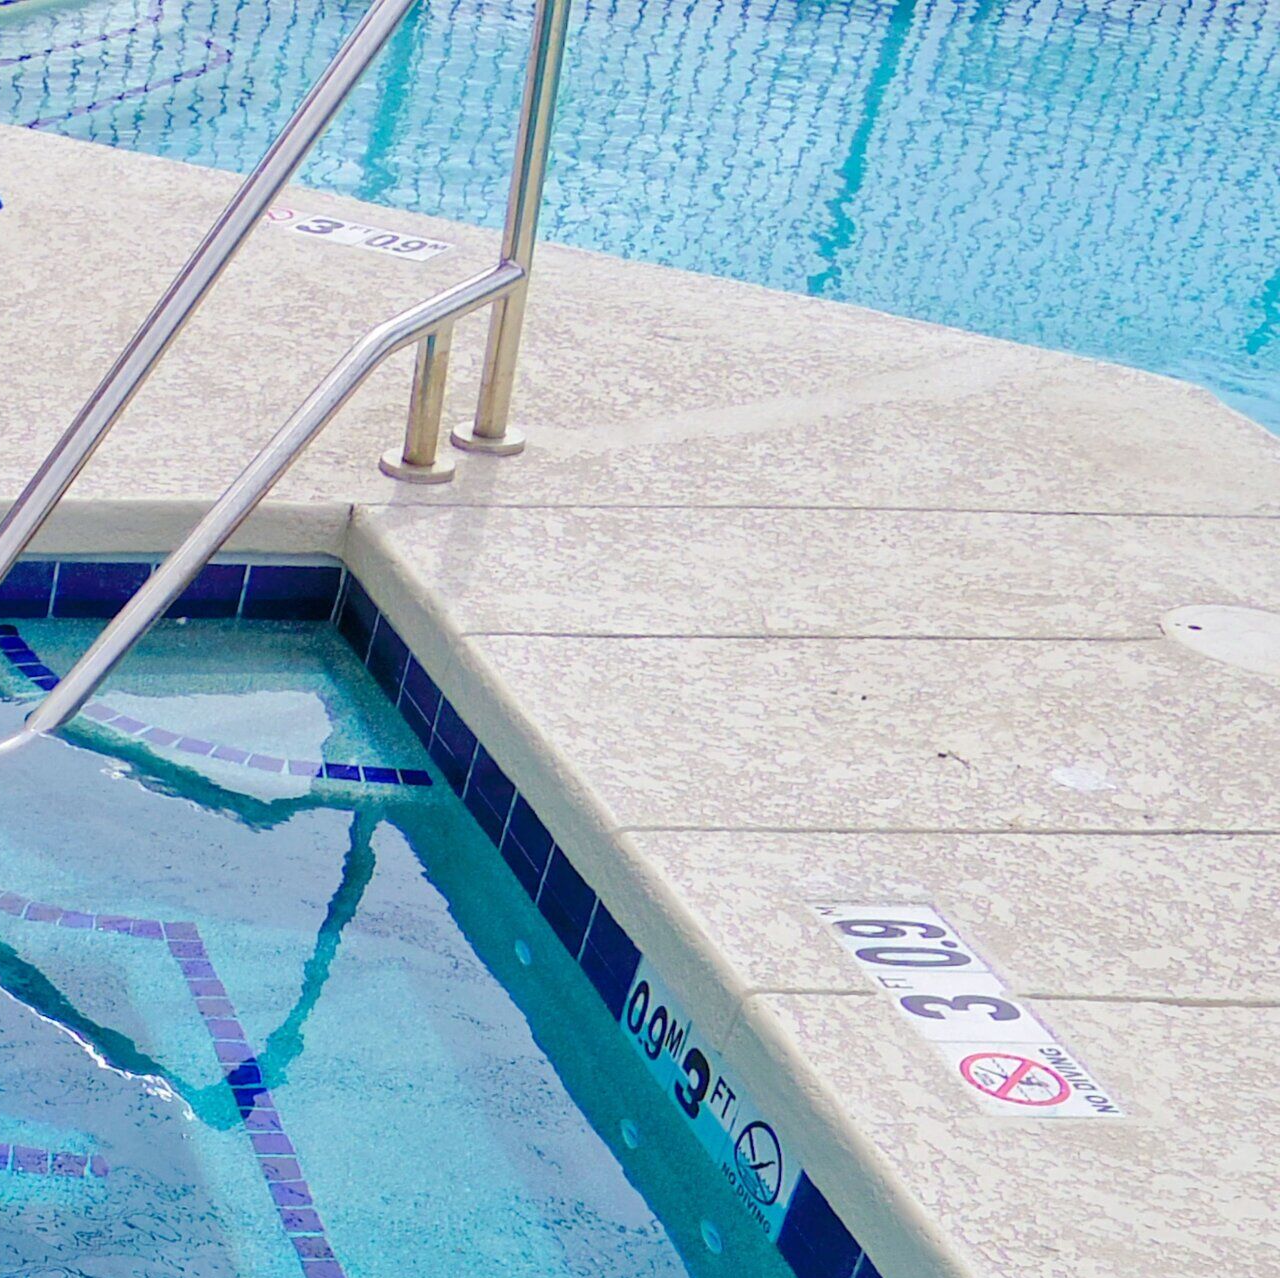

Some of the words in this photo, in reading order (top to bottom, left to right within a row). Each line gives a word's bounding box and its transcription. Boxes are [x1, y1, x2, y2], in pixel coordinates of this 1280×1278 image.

[296, 219, 345, 234] 3
[832, 919, 972, 967] 0.9
[877, 976, 913, 989] FT
[900, 994, 1021, 1021] 3
[674, 1047, 710, 1120] 3
[710, 1075, 736, 1119] FT
[1038, 1047, 1098, 1091] DIVING
[1085, 1095, 1120, 1114] NO
[722, 1161, 736, 1185] NO
[736, 1184, 771, 1234] DIVING
